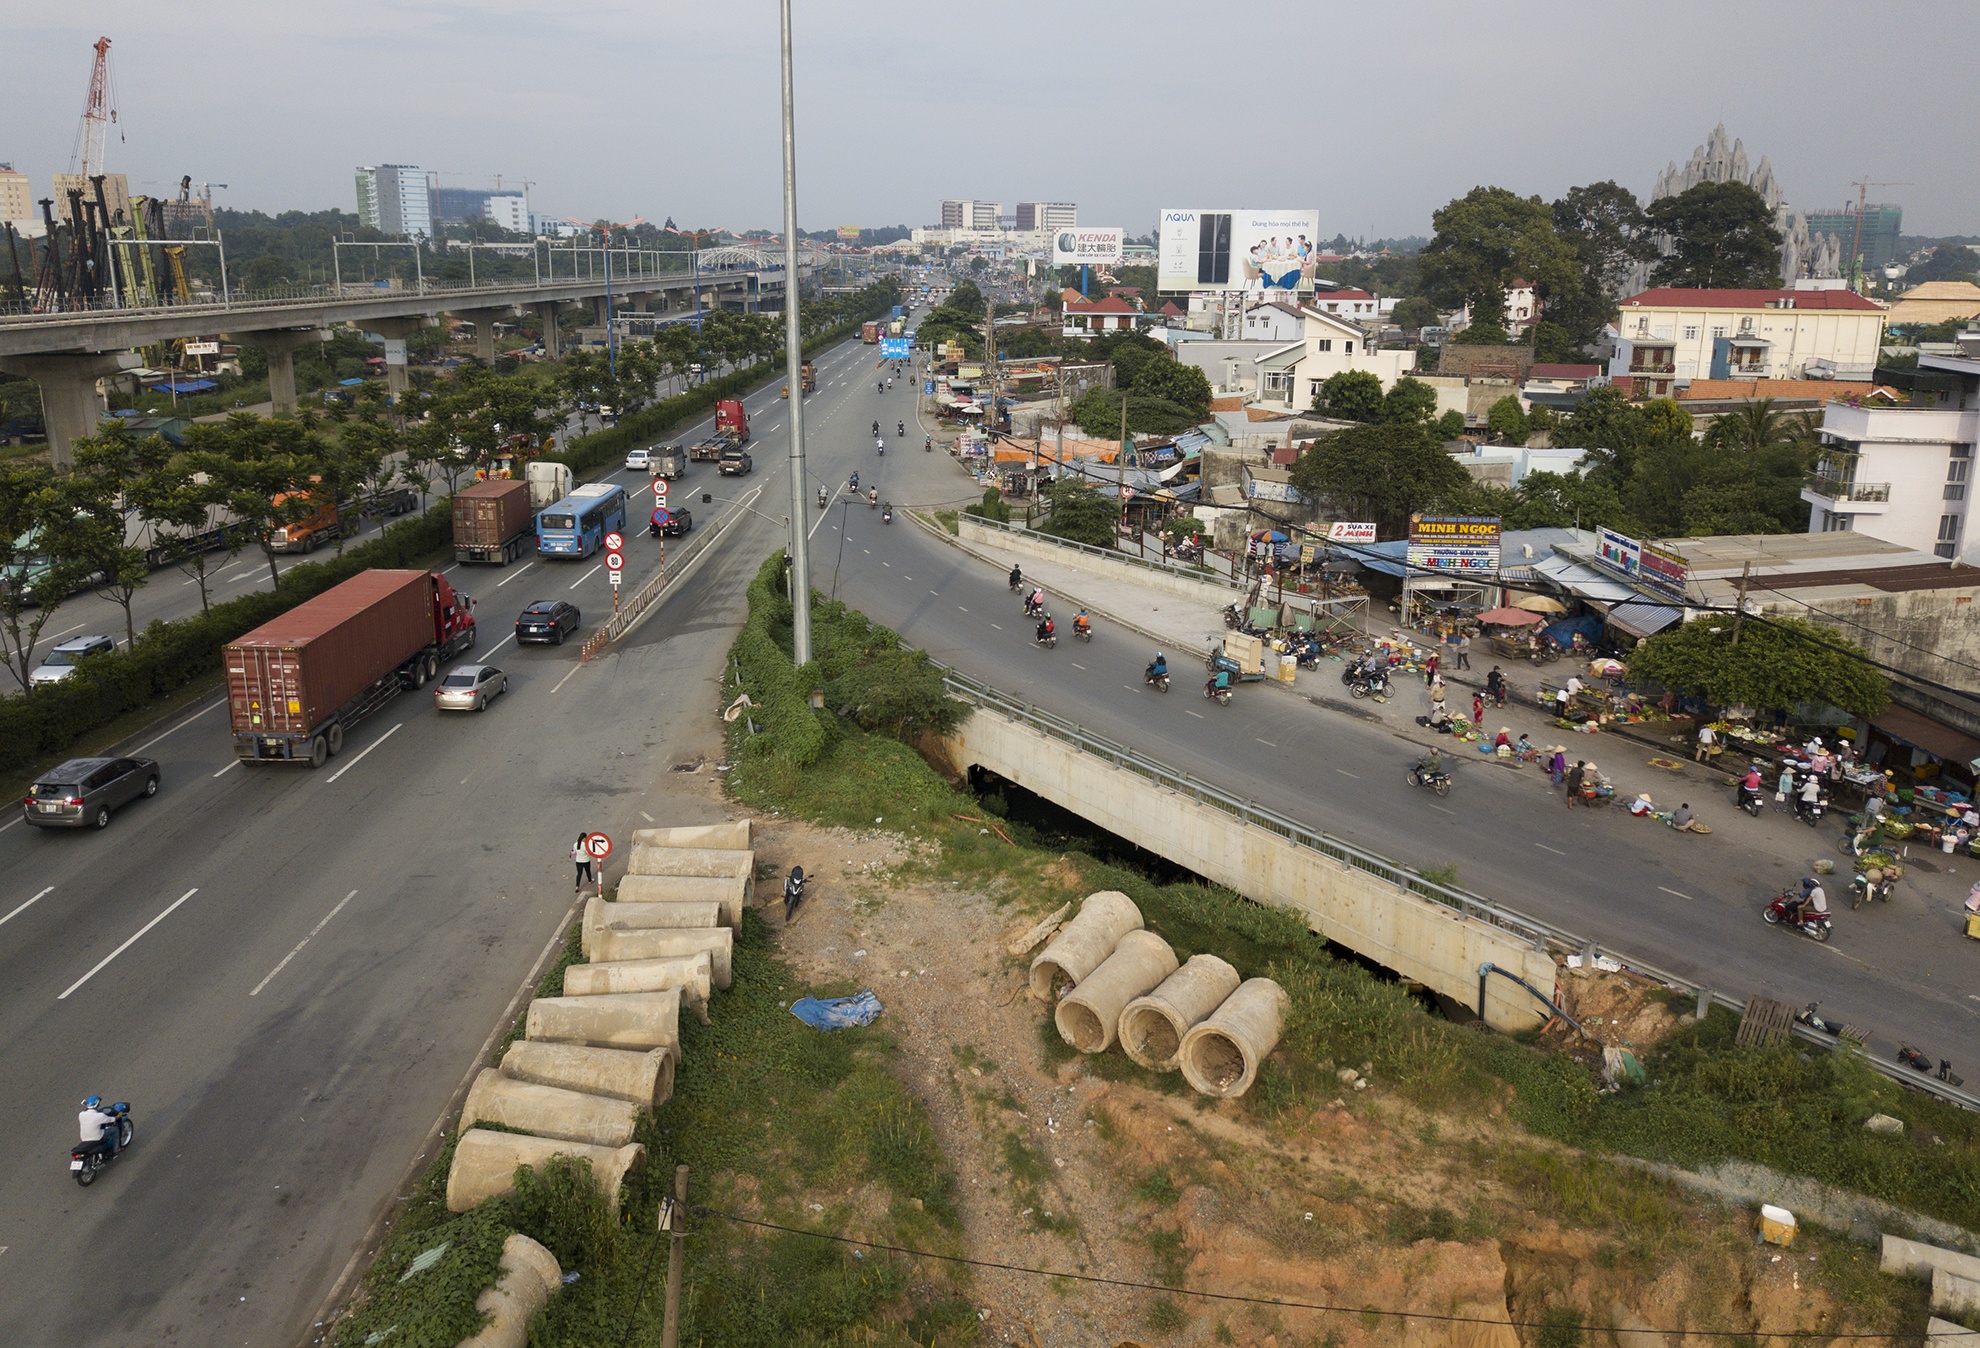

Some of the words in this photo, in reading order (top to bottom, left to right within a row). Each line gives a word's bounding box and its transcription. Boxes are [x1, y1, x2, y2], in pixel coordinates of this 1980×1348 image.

[1165, 213, 1195, 222] AQUA
[1078, 233, 1116, 242] KENDA
[1077, 243, 1116, 253] 建大輪胎
[656, 483, 665, 491] 60
[1334, 524, 1344, 536] 2
[1418, 523, 1456, 533] MINH
[1459, 524, 1497, 535] NGỌC
[611, 557, 619, 566] 80
[1602, 542, 1620, 563] Minh
[1620, 550, 1638, 572] Ngọc
[1427, 558, 1456, 567] MINH
[1461, 558, 1494, 569] NGỌC
